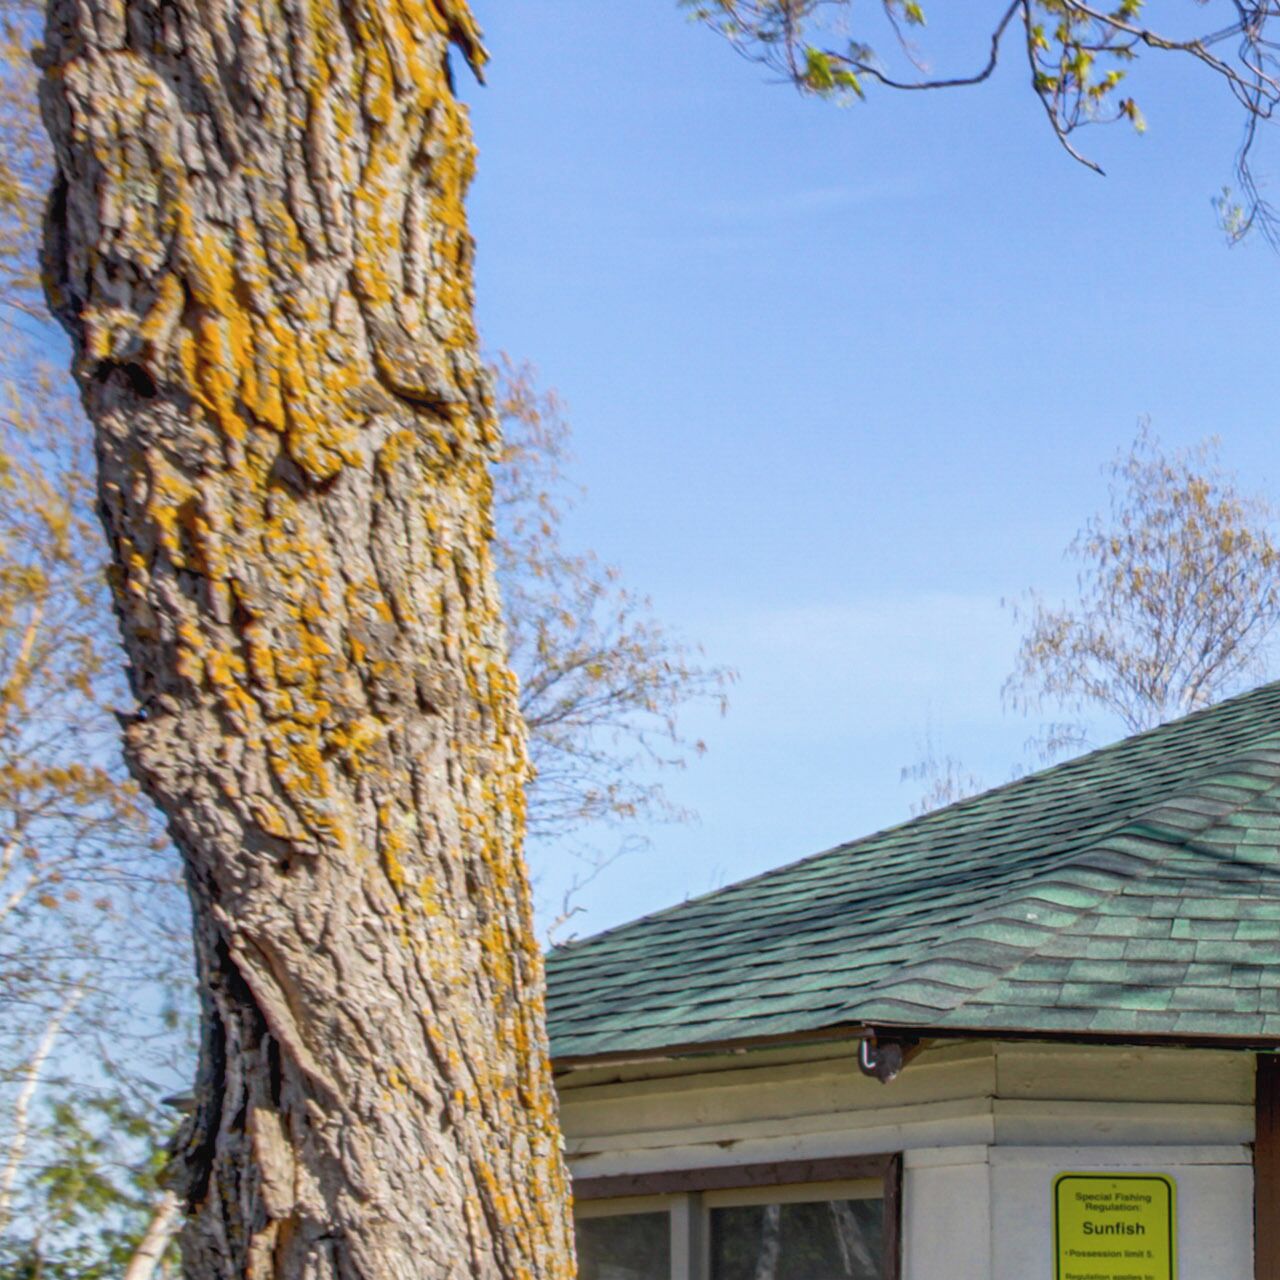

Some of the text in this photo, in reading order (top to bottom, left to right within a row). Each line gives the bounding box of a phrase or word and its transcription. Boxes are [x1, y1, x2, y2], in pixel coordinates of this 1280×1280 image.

[1075, 1192, 1152, 1204] Special Fishing
[1083, 1221, 1145, 1235] Sunfish
[1069, 1249, 1122, 1258] Possession
[1124, 1250, 1144, 1258] limit
